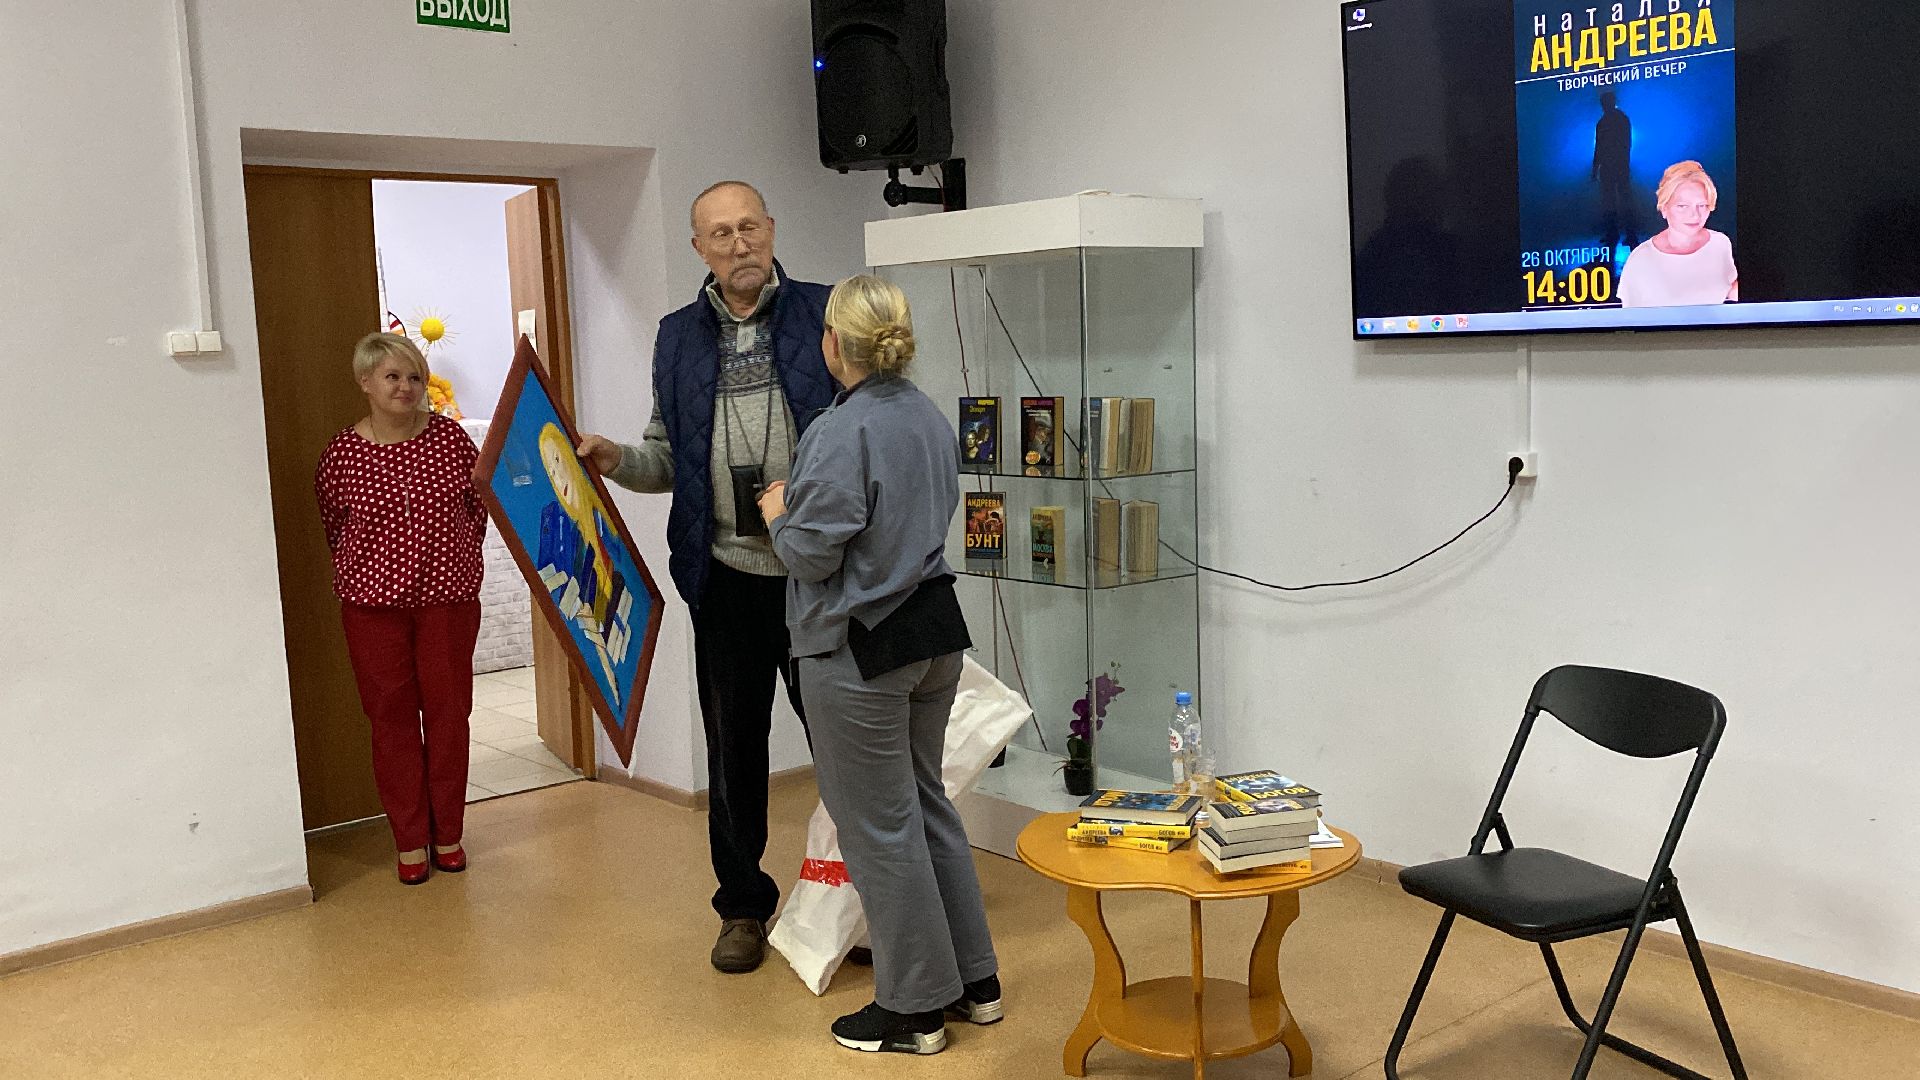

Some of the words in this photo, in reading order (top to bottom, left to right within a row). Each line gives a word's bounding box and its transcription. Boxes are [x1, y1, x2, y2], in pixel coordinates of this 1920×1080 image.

[1530, 8, 1718, 73] АНДРЕЕВА
[1557, 66, 1640, 91] ТВОРЧЕСКИЙ
[1644, 62, 1687, 79] ВЕЧЕР
[1521, 251, 1540, 268] 26
[1544, 246, 1610, 267] ОКТЯБРЯ
[1522, 266, 1611, 304] 14:00
[966, 533, 1001, 549] БУНТ
